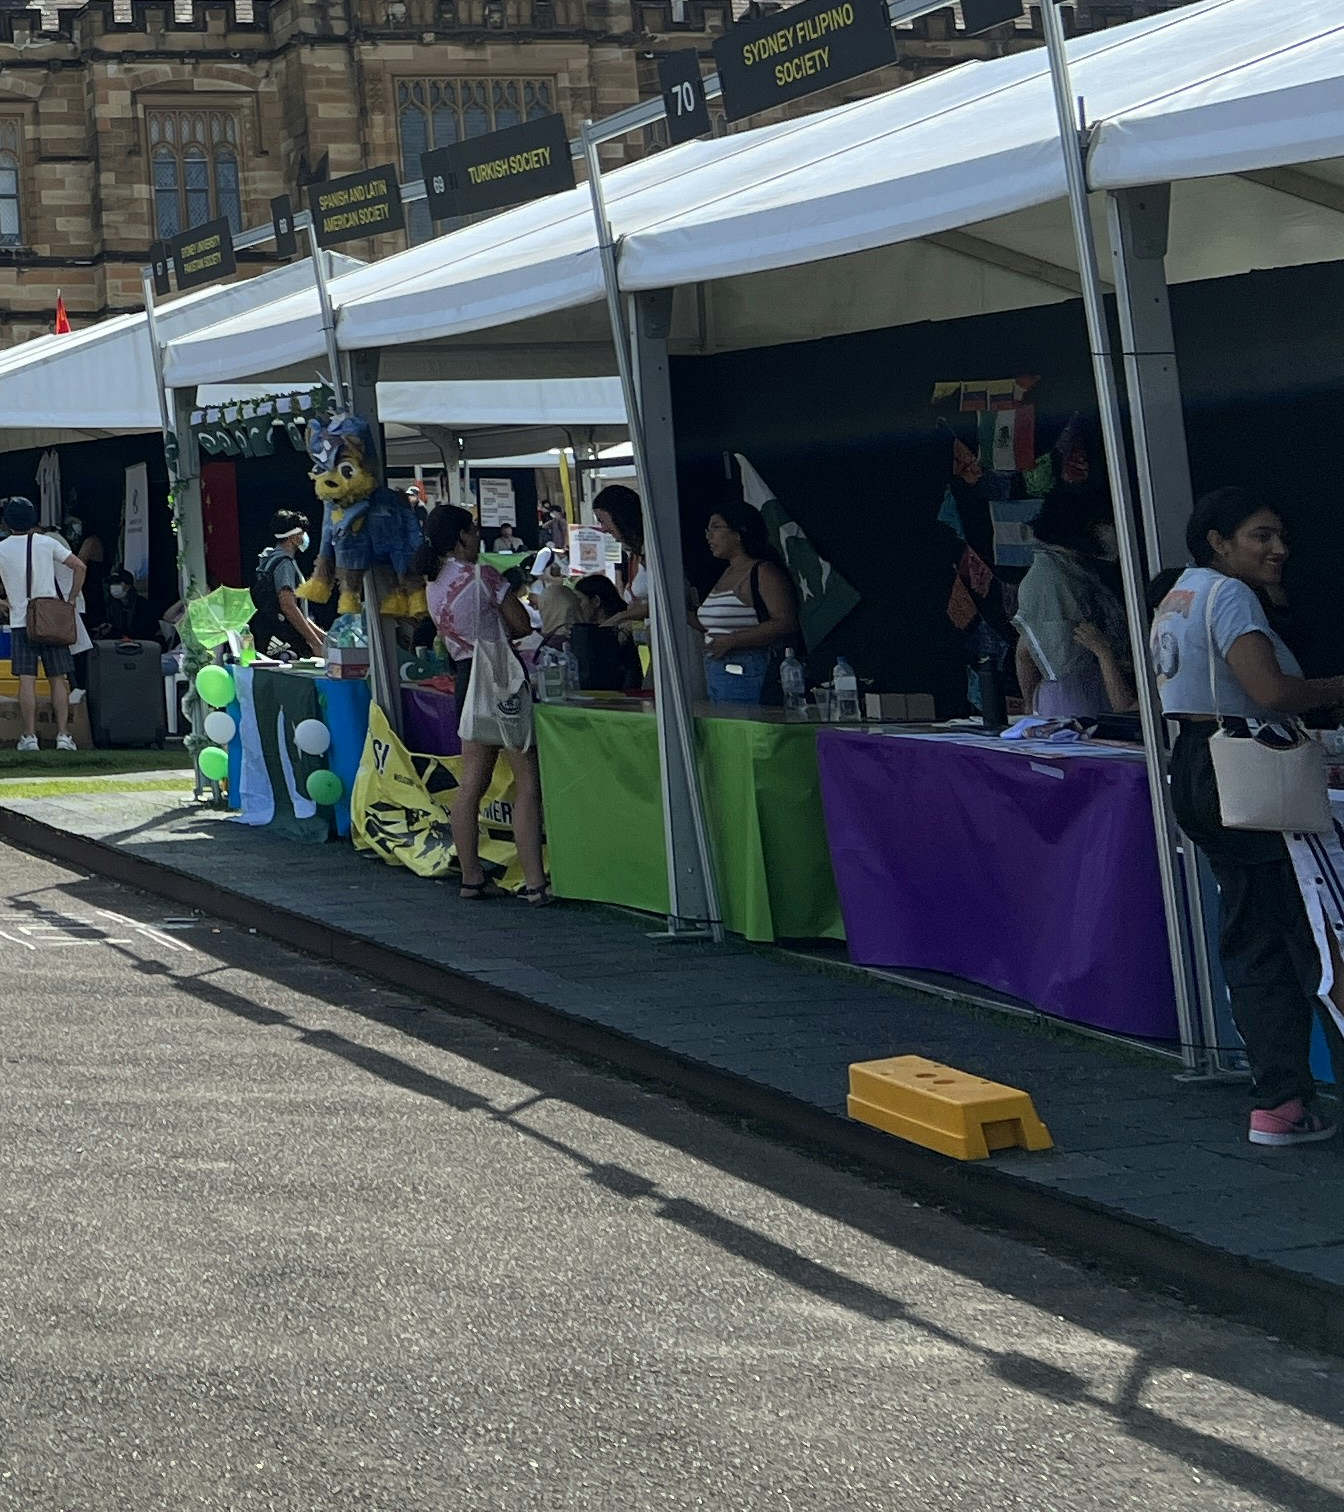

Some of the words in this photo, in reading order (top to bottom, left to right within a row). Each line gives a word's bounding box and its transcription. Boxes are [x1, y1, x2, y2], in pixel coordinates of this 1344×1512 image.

[743, 27, 793, 65] SYDNEY
[796, 3, 853, 44] FILIPINO
[775, 46, 830, 85] SOCIETY
[672, 81, 694, 116] 70
[467, 157, 509, 185] TURKISH
[510, 146, 552, 174] SOCIETY
[319, 189, 349, 211] SPANISH
[349, 185, 365, 203] AND
[364, 179, 387, 199] LATIN
[432, 175, 445, 193] 69
[358, 203, 389, 225] SOCIETY
